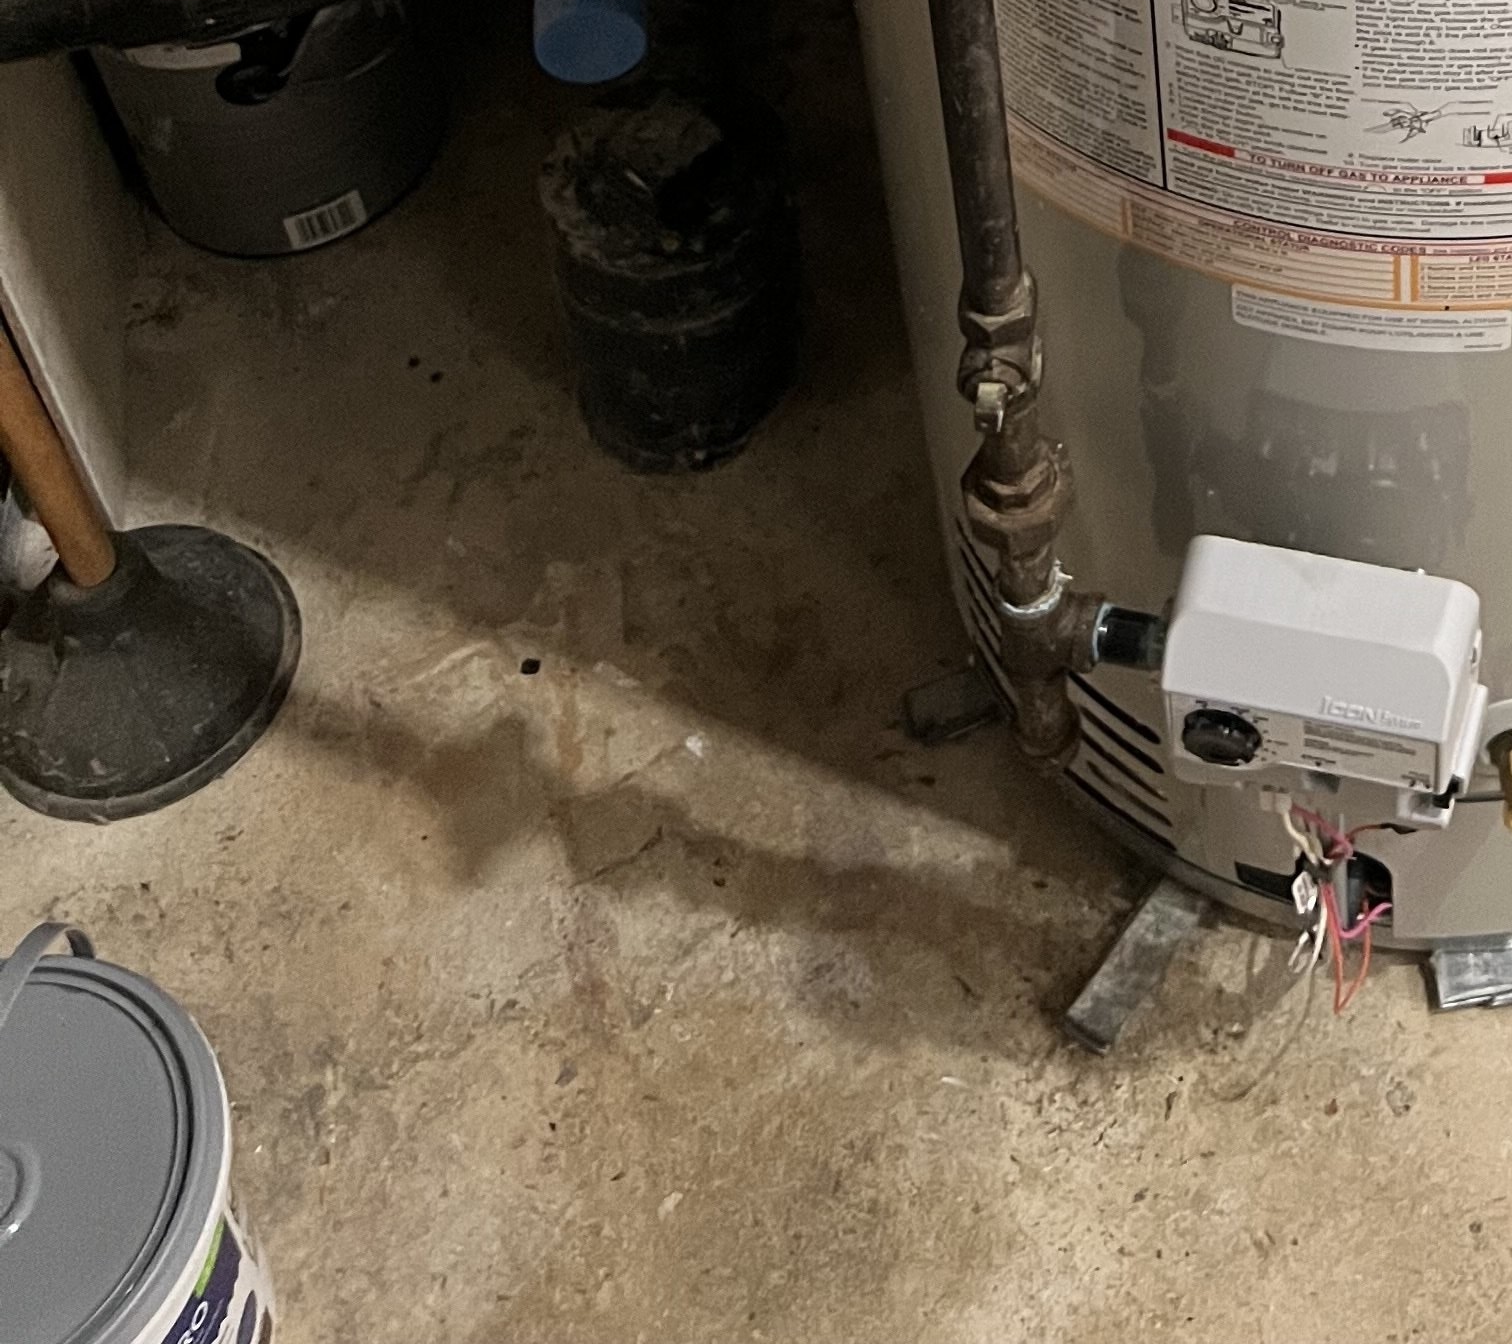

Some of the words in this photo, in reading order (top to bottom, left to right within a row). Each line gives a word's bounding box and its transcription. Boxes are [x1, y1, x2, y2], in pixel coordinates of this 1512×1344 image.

[1250, 153, 1266, 165] TO
[1271, 158, 1305, 173] TURN
[1309, 165, 1334, 176] OFF
[1339, 170, 1366, 181] GAS
[1371, 173, 1388, 182] TO
[1392, 174, 1468, 184] APPLIANCE
[1233, 219, 1293, 241] CONTROL
[1298, 233, 1378, 252] DIAGNOSTIC
[1381, 243, 1427, 254] CODES
